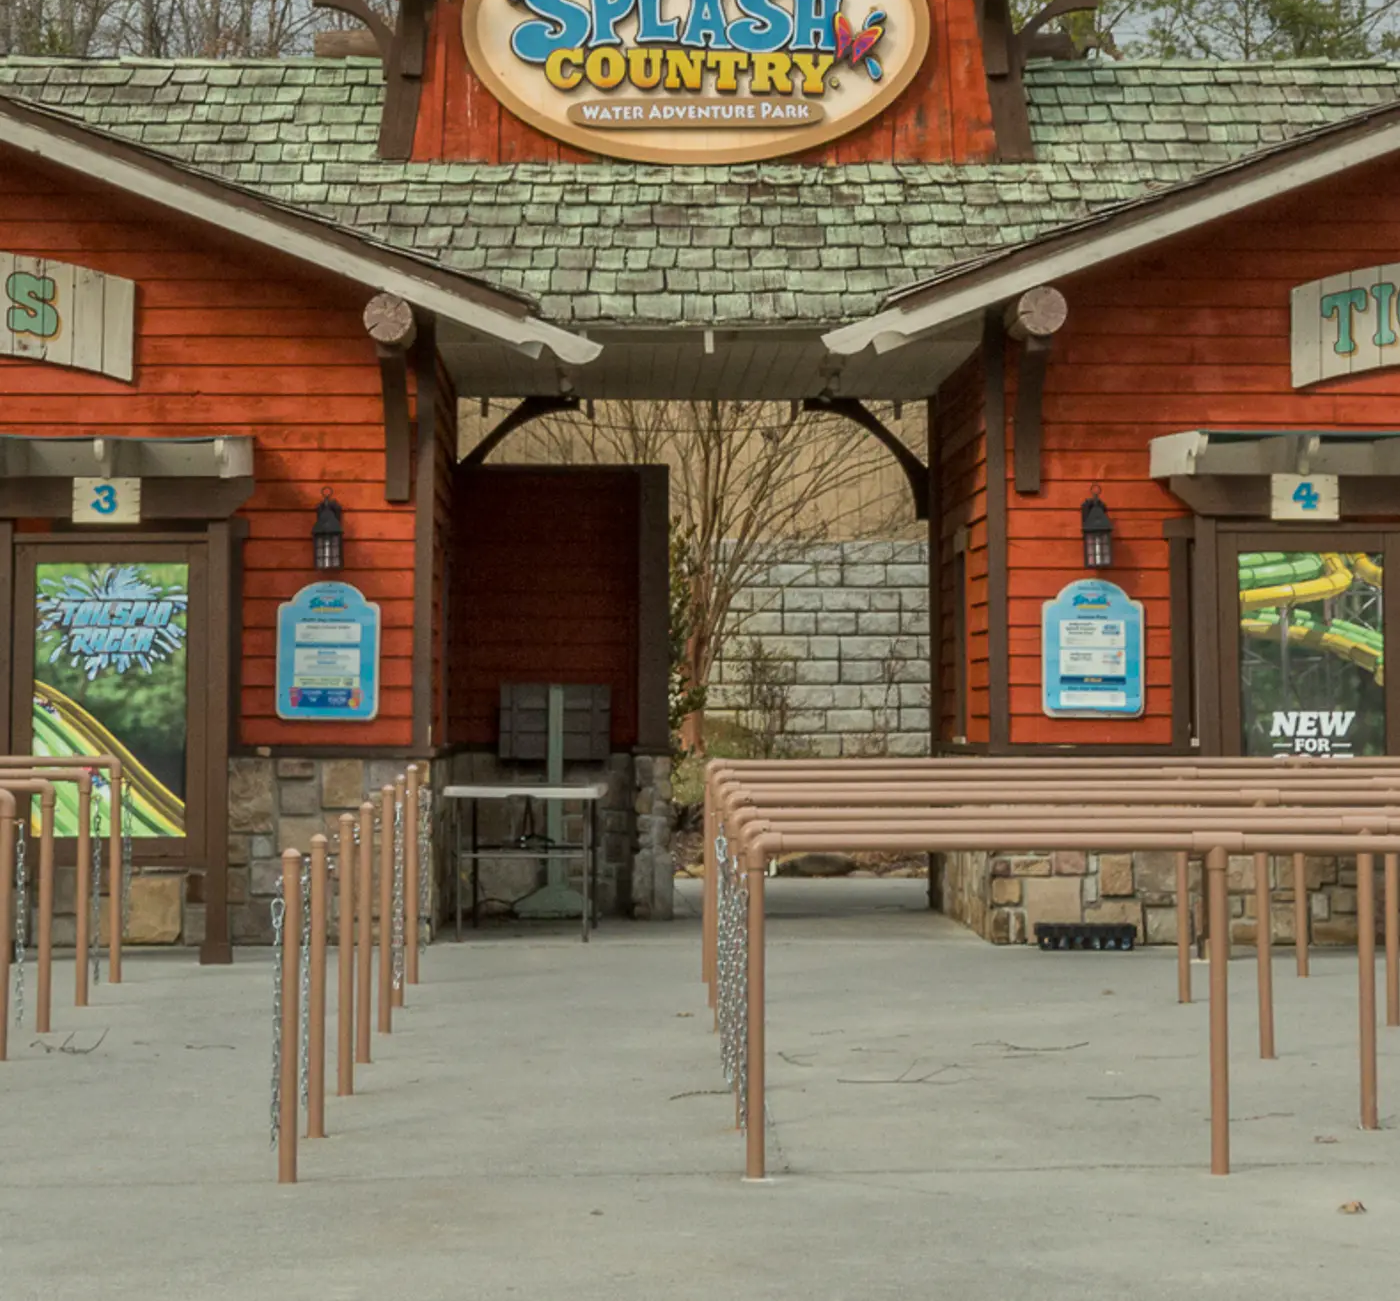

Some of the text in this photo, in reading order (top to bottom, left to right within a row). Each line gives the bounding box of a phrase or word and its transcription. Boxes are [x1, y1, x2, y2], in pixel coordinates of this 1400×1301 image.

[545, 48, 835, 94] COUNTRY
[582, 101, 810, 120] WATER ADVENTURE PARK
[1320, 282, 1400, 355] TI
[90, 484, 117, 514] 3
[1292, 482, 1320, 510] 4
[58, 600, 174, 627] TAILSPIN
[69, 627, 157, 656] RACER
[1269, 710, 1357, 737] NEW
[1294, 738, 1331, 753] FOR
